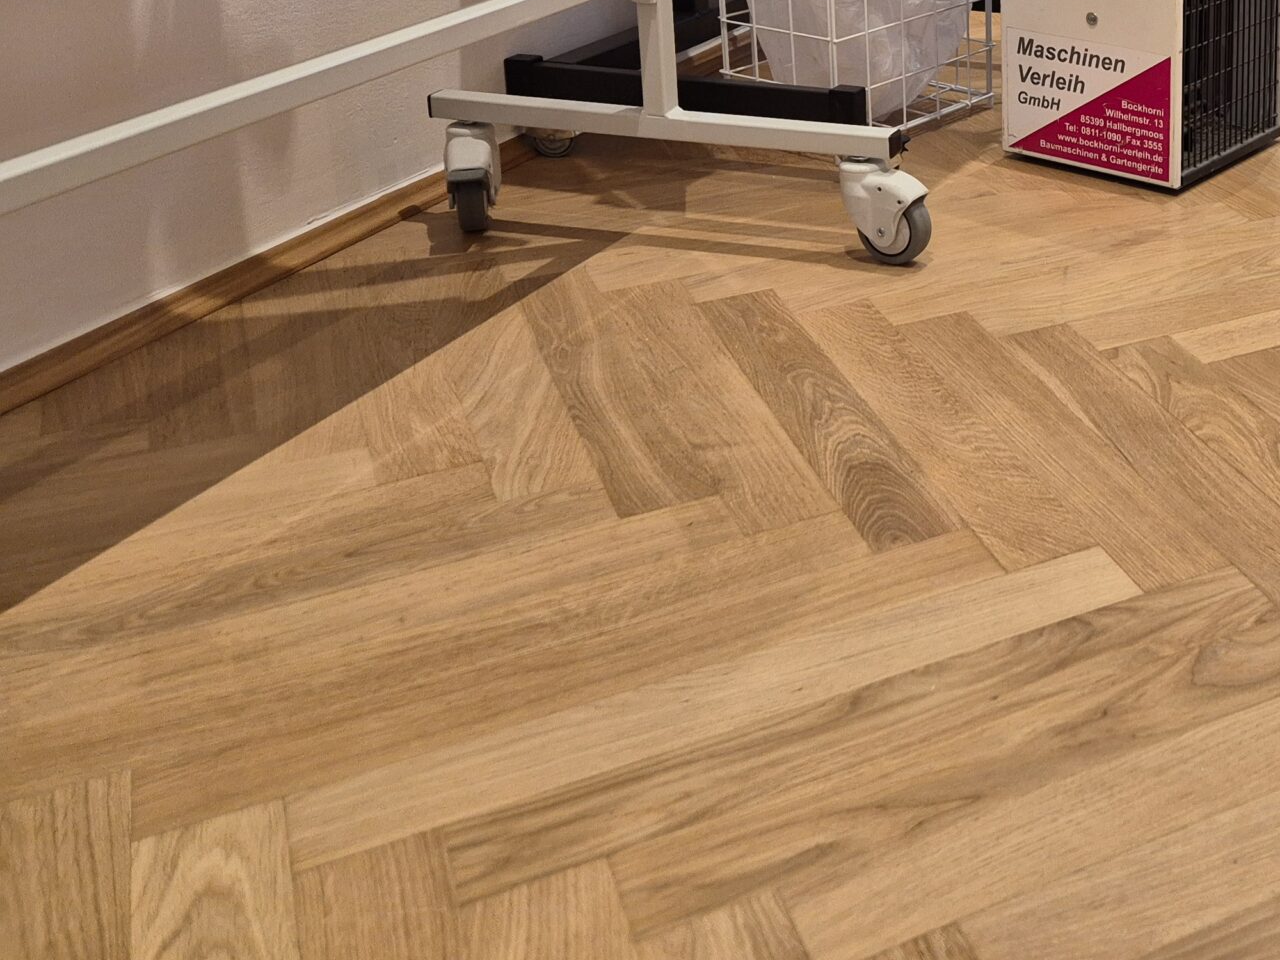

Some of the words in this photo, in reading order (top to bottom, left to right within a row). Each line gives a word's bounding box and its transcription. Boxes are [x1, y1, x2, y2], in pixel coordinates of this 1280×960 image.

[1016, 36, 1126, 74] Maschinen
[1018, 64, 1086, 94] Verleih
[1017, 91, 1061, 112] GmbH
[1121, 100, 1165, 117] Bockhorni
[1080, 114, 1105, 127] 85399
[1106, 120, 1164, 141] Hallbergmoos
[1105, 108, 1151, 126] Wilhelmstr.
[1154, 119, 1164, 129] 13
[1057, 133, 1164, 164] www.bockhorni-verleih.de
[1064, 122, 1079, 133] Tel:
[1125, 136, 1141, 147] Fax
[1143, 140, 1163, 152] 3555
[1039, 139, 1099, 161] Baumaschinen
[1100, 152, 1108, 163] &
[1109, 155, 1164, 175] Gartengeräte
